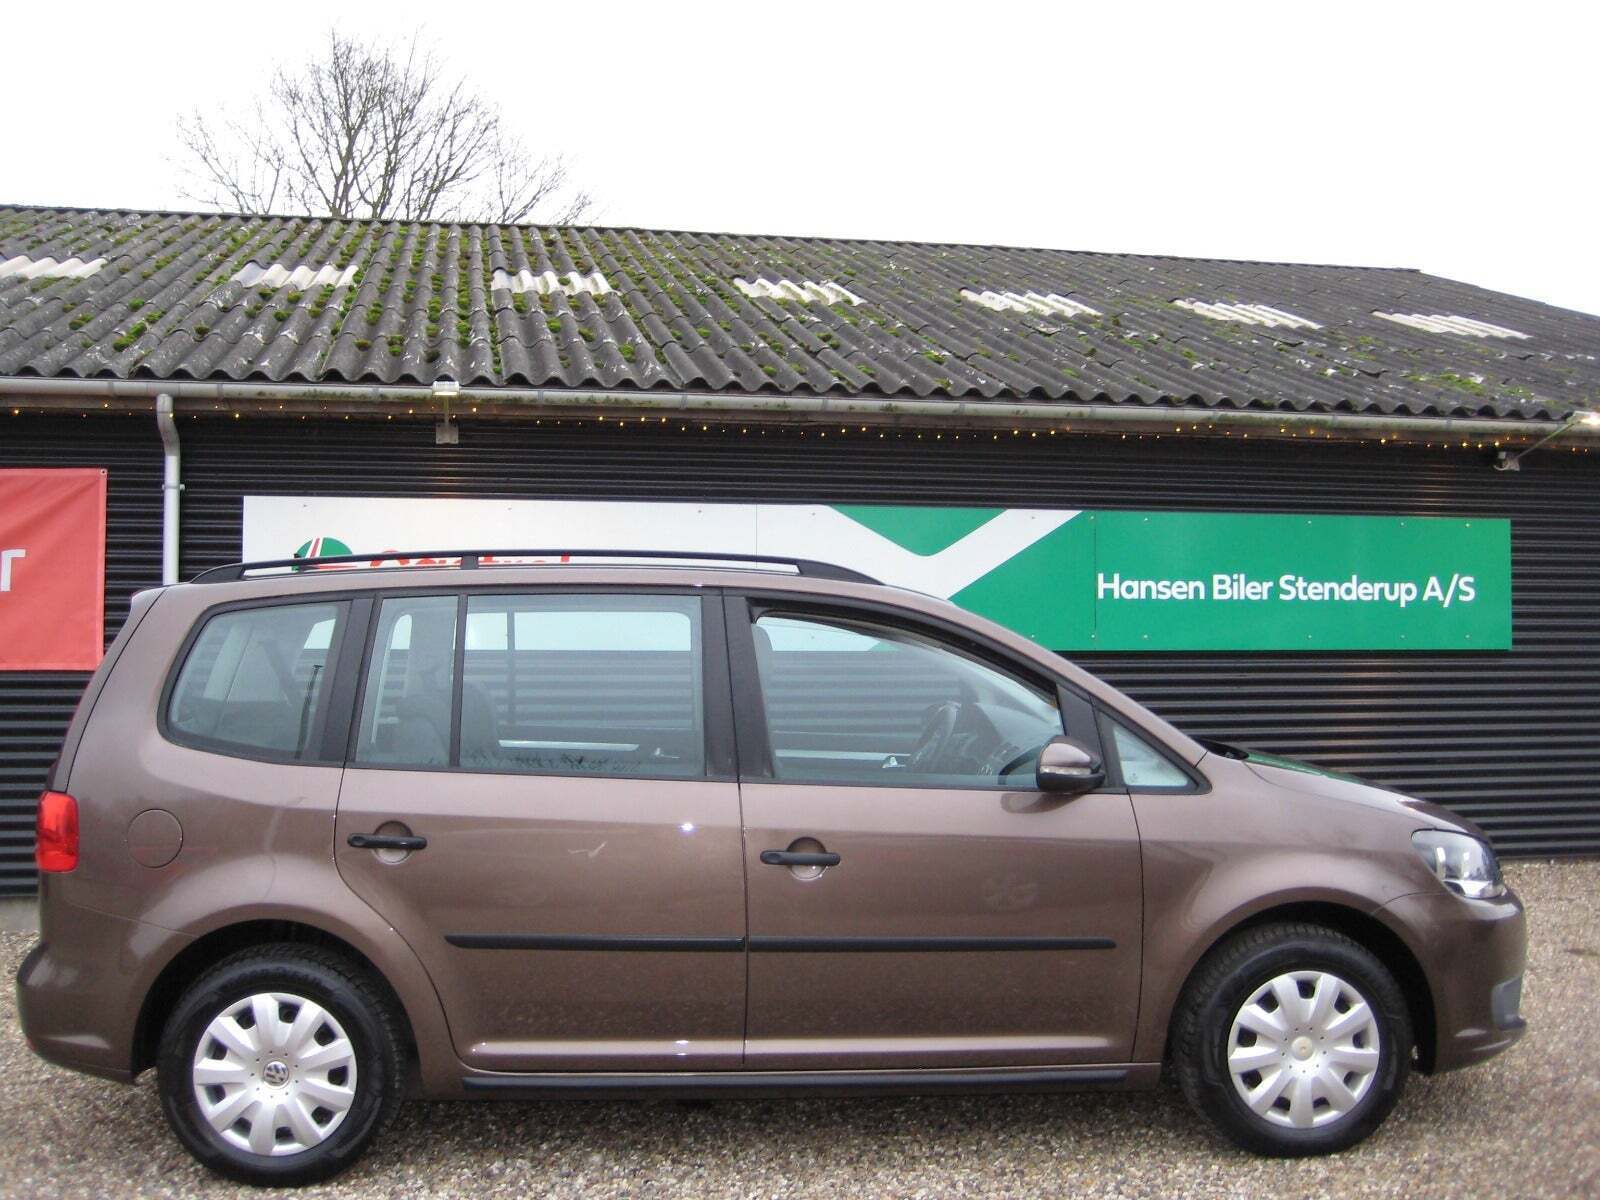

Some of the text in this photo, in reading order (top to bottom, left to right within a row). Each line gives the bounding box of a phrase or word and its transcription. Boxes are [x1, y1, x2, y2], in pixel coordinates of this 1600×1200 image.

[1097, 572, 1476, 608] Hansen Biler Stenderup A/S
